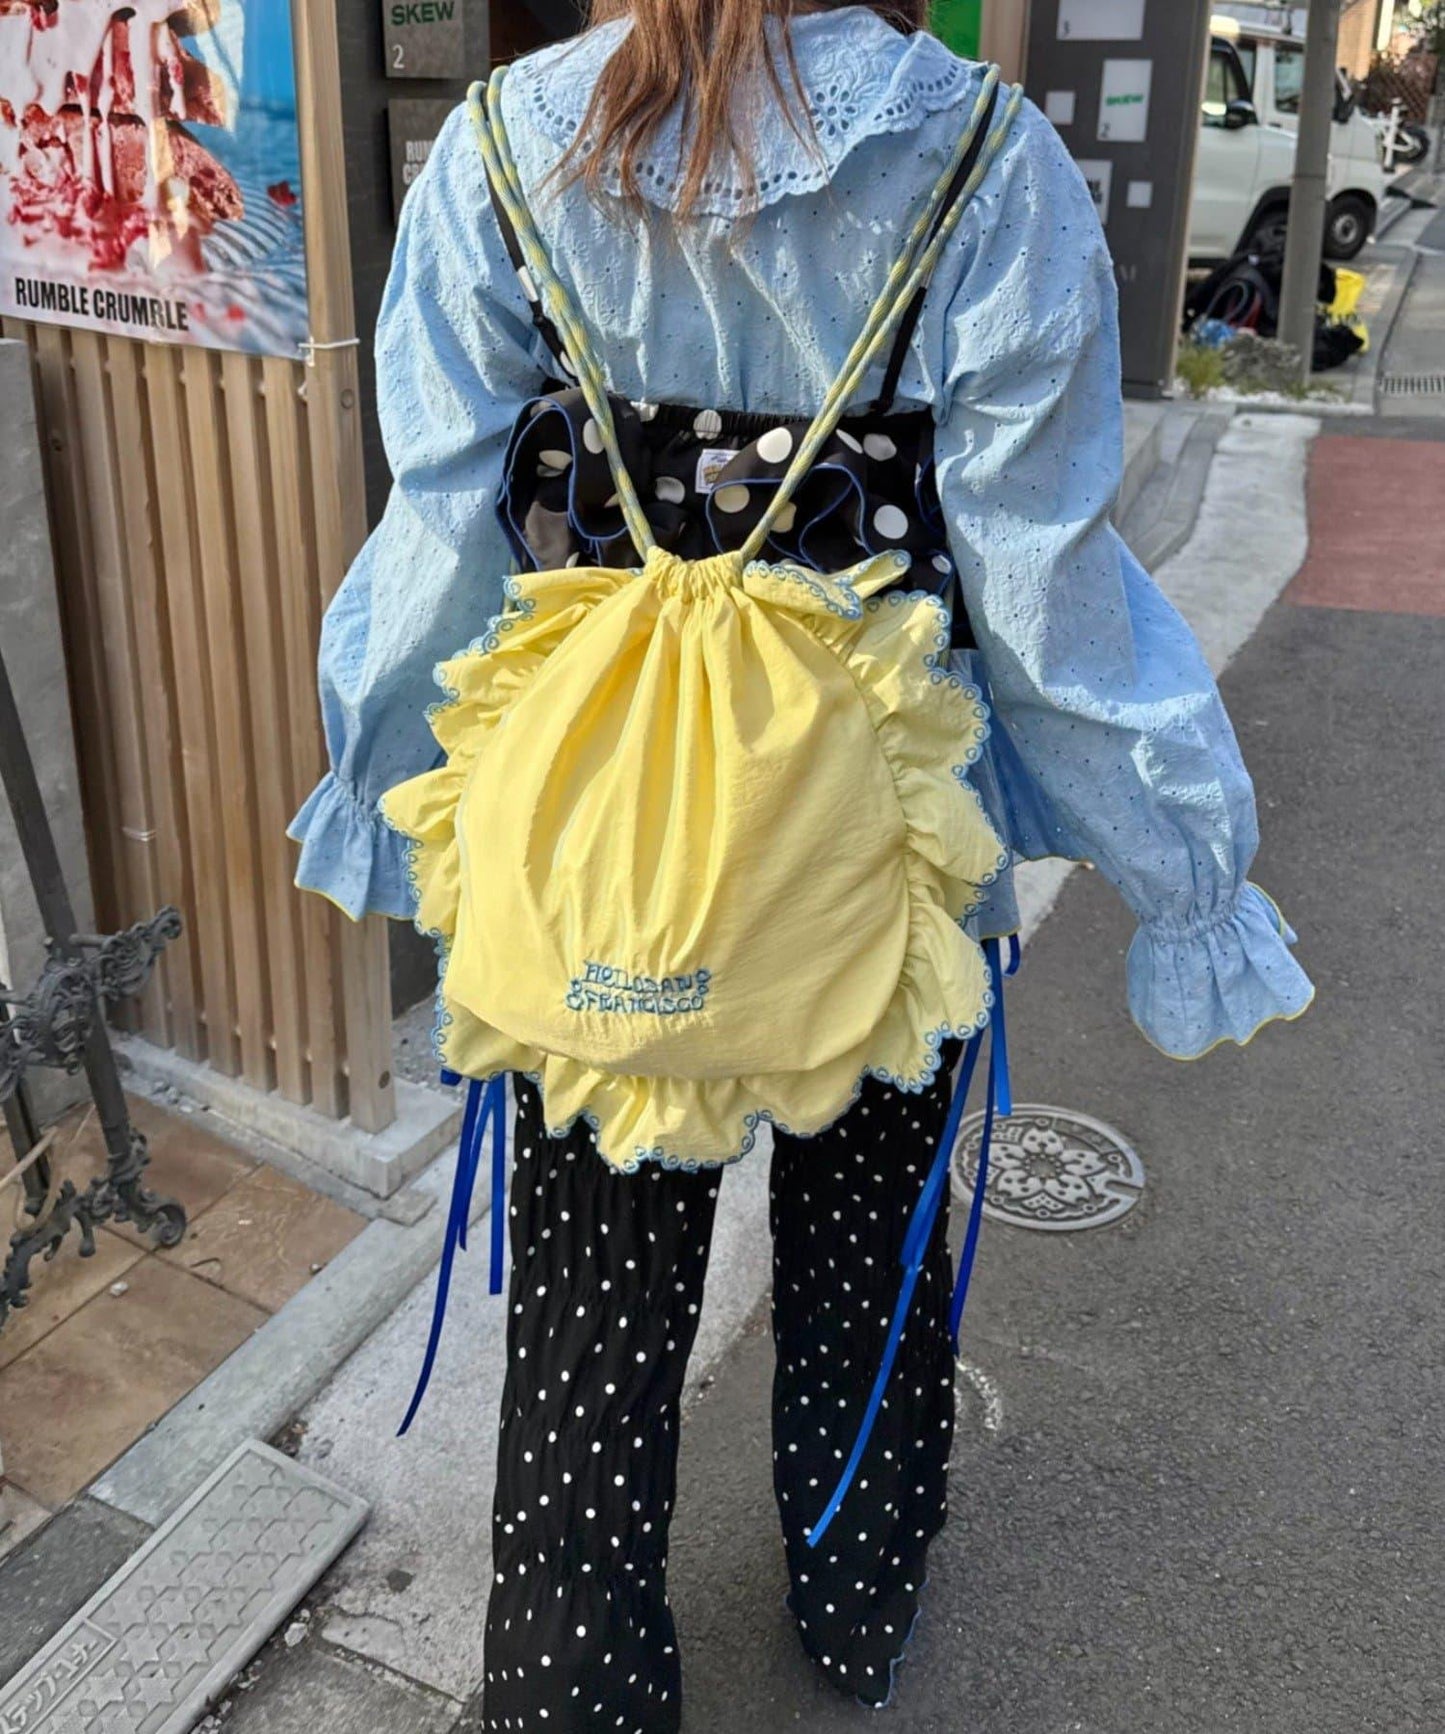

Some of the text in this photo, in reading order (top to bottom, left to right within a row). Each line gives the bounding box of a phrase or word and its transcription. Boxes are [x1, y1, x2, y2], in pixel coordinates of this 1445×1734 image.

[391, 1, 455, 26] SKEW
[392, 44, 405, 69] 2
[15, 277, 90, 315] RUMBLE
